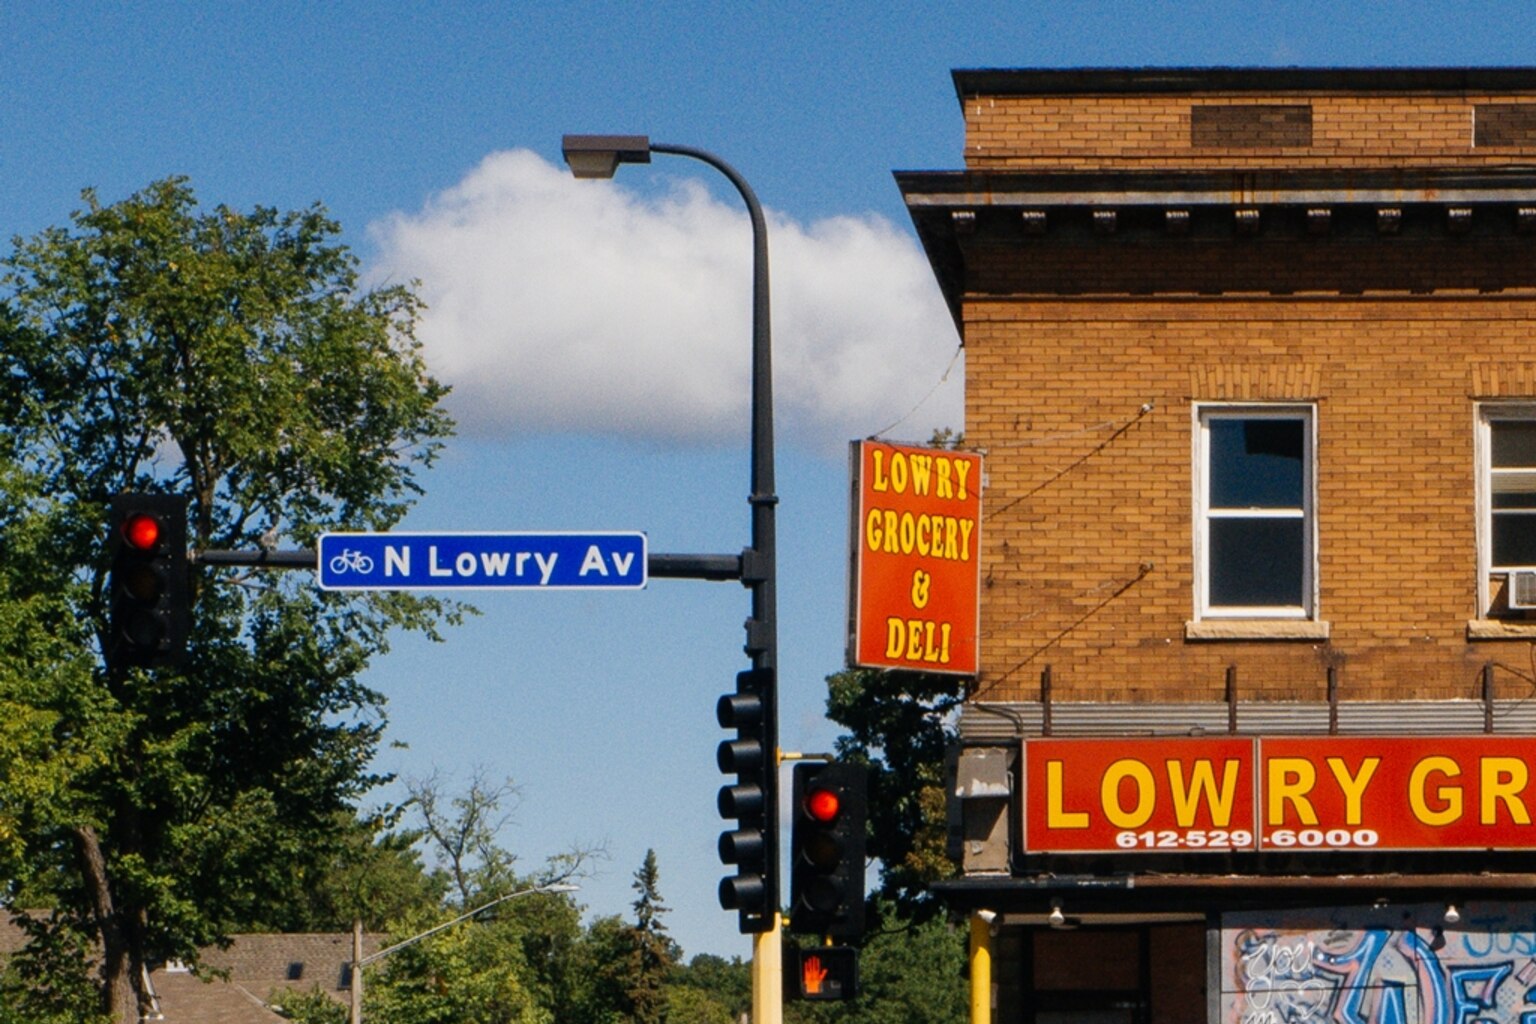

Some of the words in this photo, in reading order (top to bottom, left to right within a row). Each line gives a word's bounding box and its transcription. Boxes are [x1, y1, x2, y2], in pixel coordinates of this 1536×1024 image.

[872, 449, 972, 501] LOWRY
[866, 508, 974, 561] GROCERY
[384, 545, 411, 577] N
[428, 545, 558, 585] Lowry
[579, 545, 635, 577] Av
[911, 569, 929, 609] &
[886, 618, 952, 664] DELI
[1046, 756, 1381, 830] LOWRY
